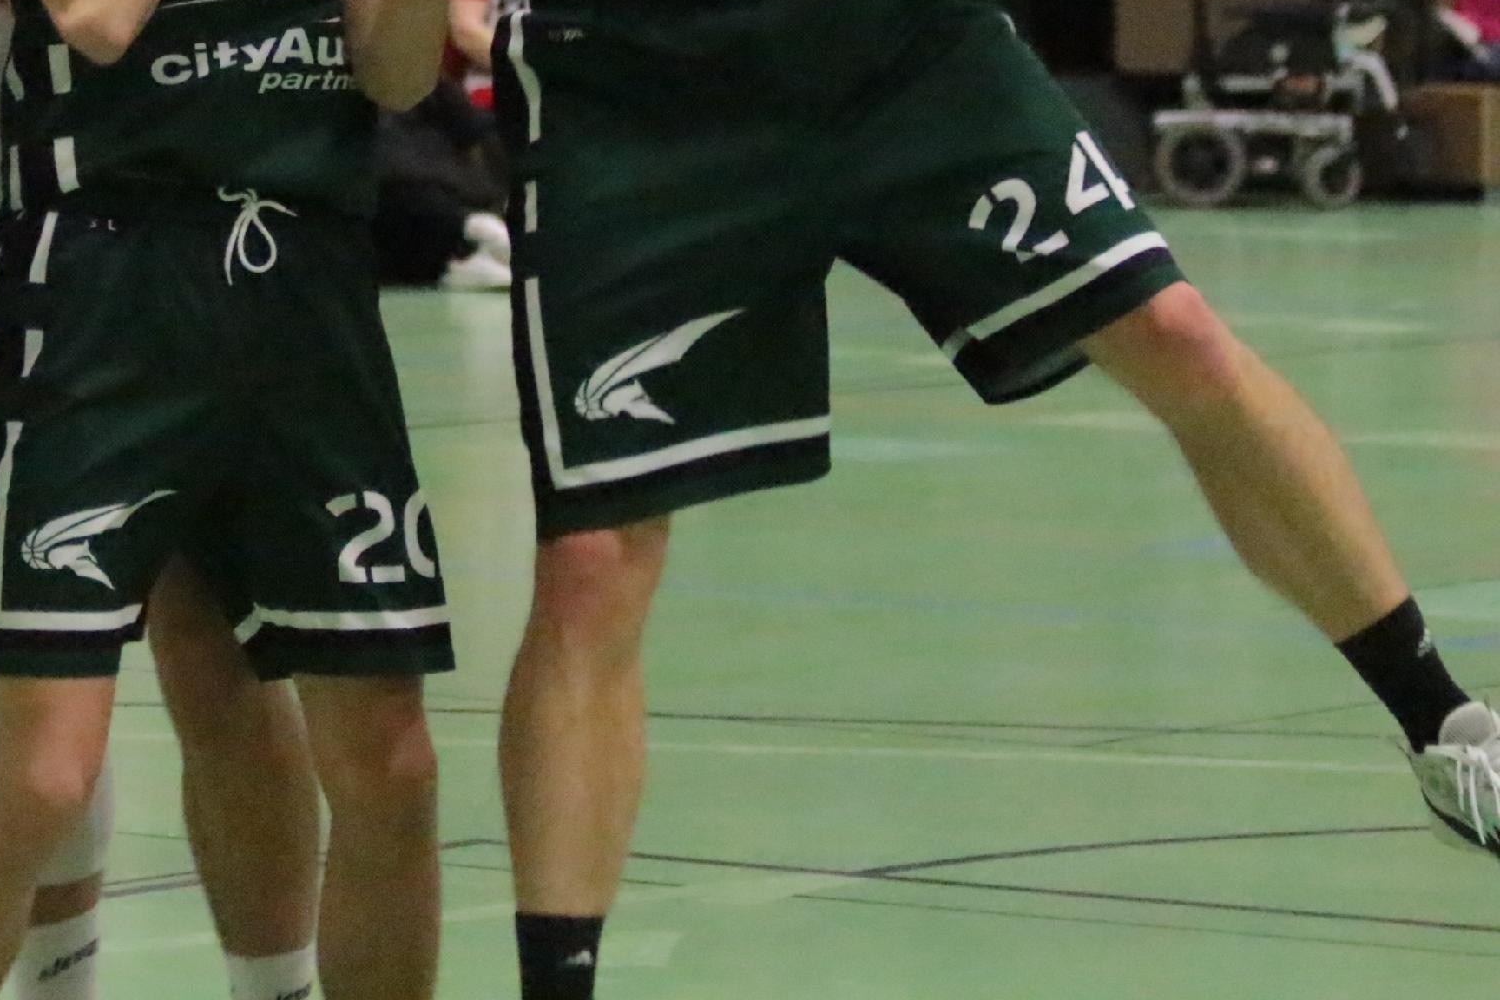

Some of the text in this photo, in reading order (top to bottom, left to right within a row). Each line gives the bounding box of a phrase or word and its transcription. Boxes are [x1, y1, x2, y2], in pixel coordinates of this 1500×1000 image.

[150, 26, 346, 86] cityAu
[257, 69, 352, 95] partn
[967, 130, 1137, 265] 24
[325, 489, 437, 584] 20
